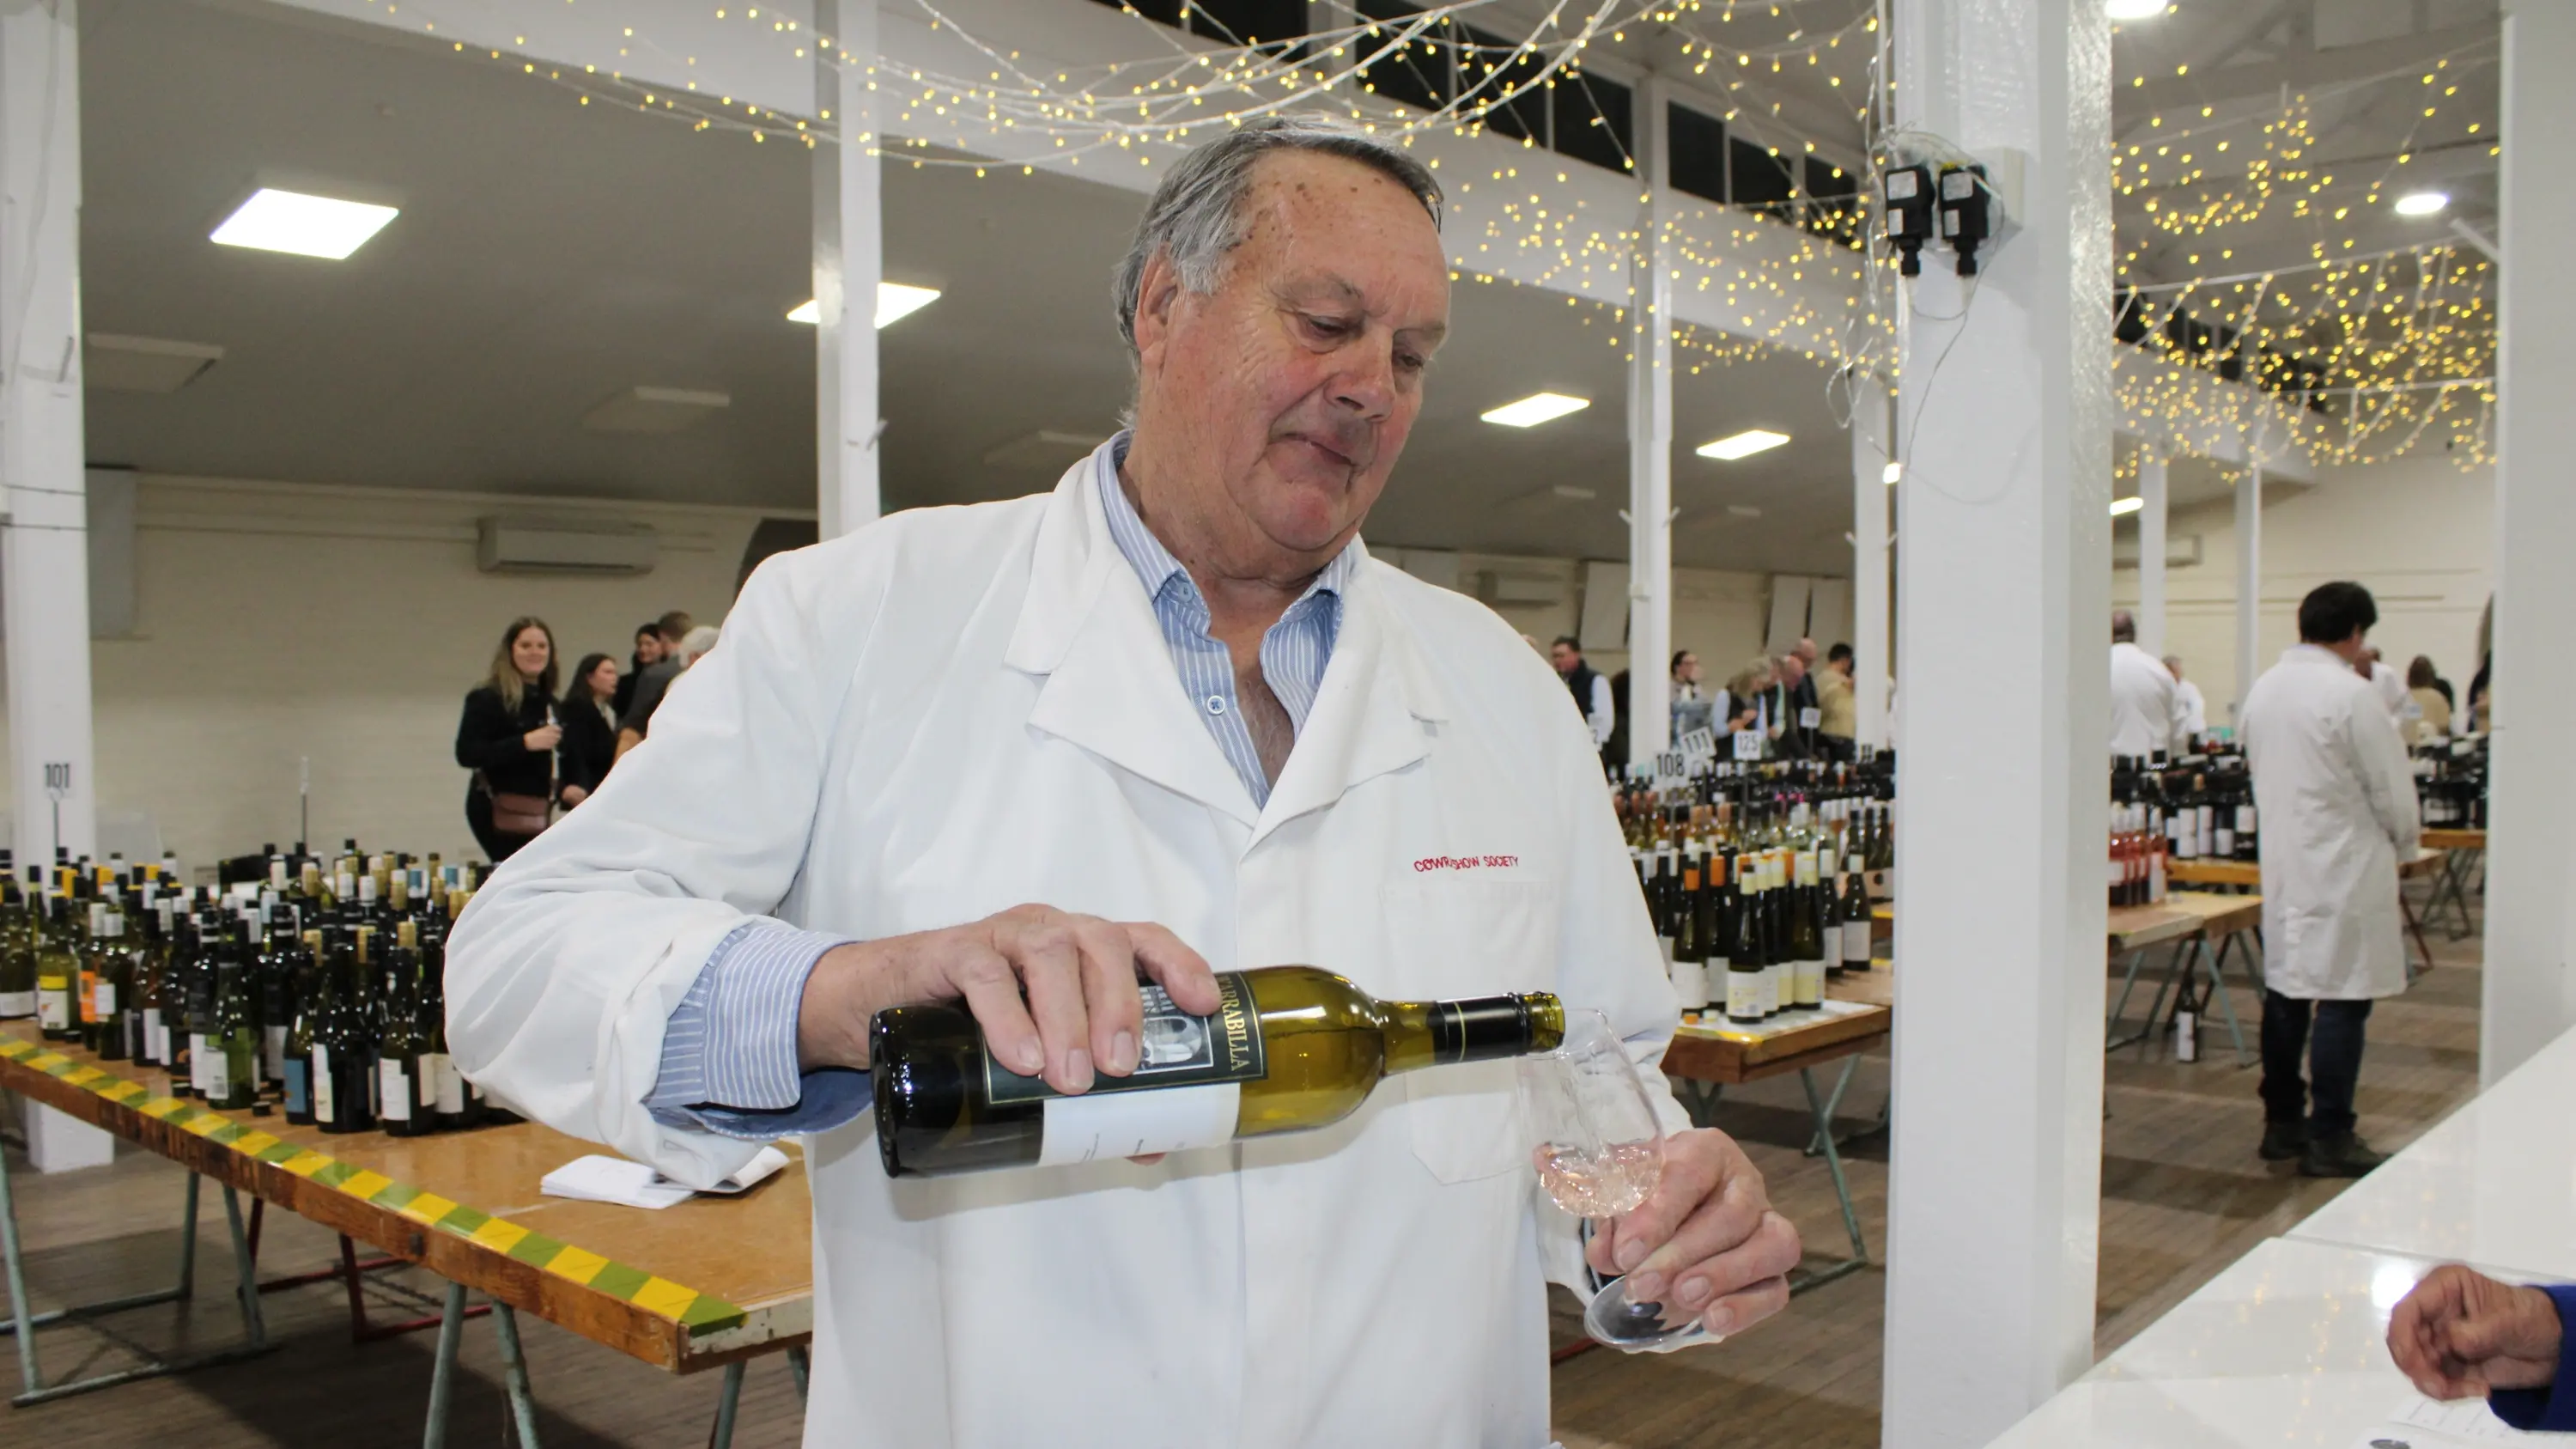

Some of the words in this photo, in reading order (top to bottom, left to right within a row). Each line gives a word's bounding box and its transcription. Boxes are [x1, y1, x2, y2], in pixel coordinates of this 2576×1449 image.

[1684, 732, 1710, 753] 111
[45, 763, 70, 788] 101
[1656, 753, 1685, 776] 108
[1413, 855, 1450, 873] COWR
[1483, 855, 1518, 868] SOCIETY
